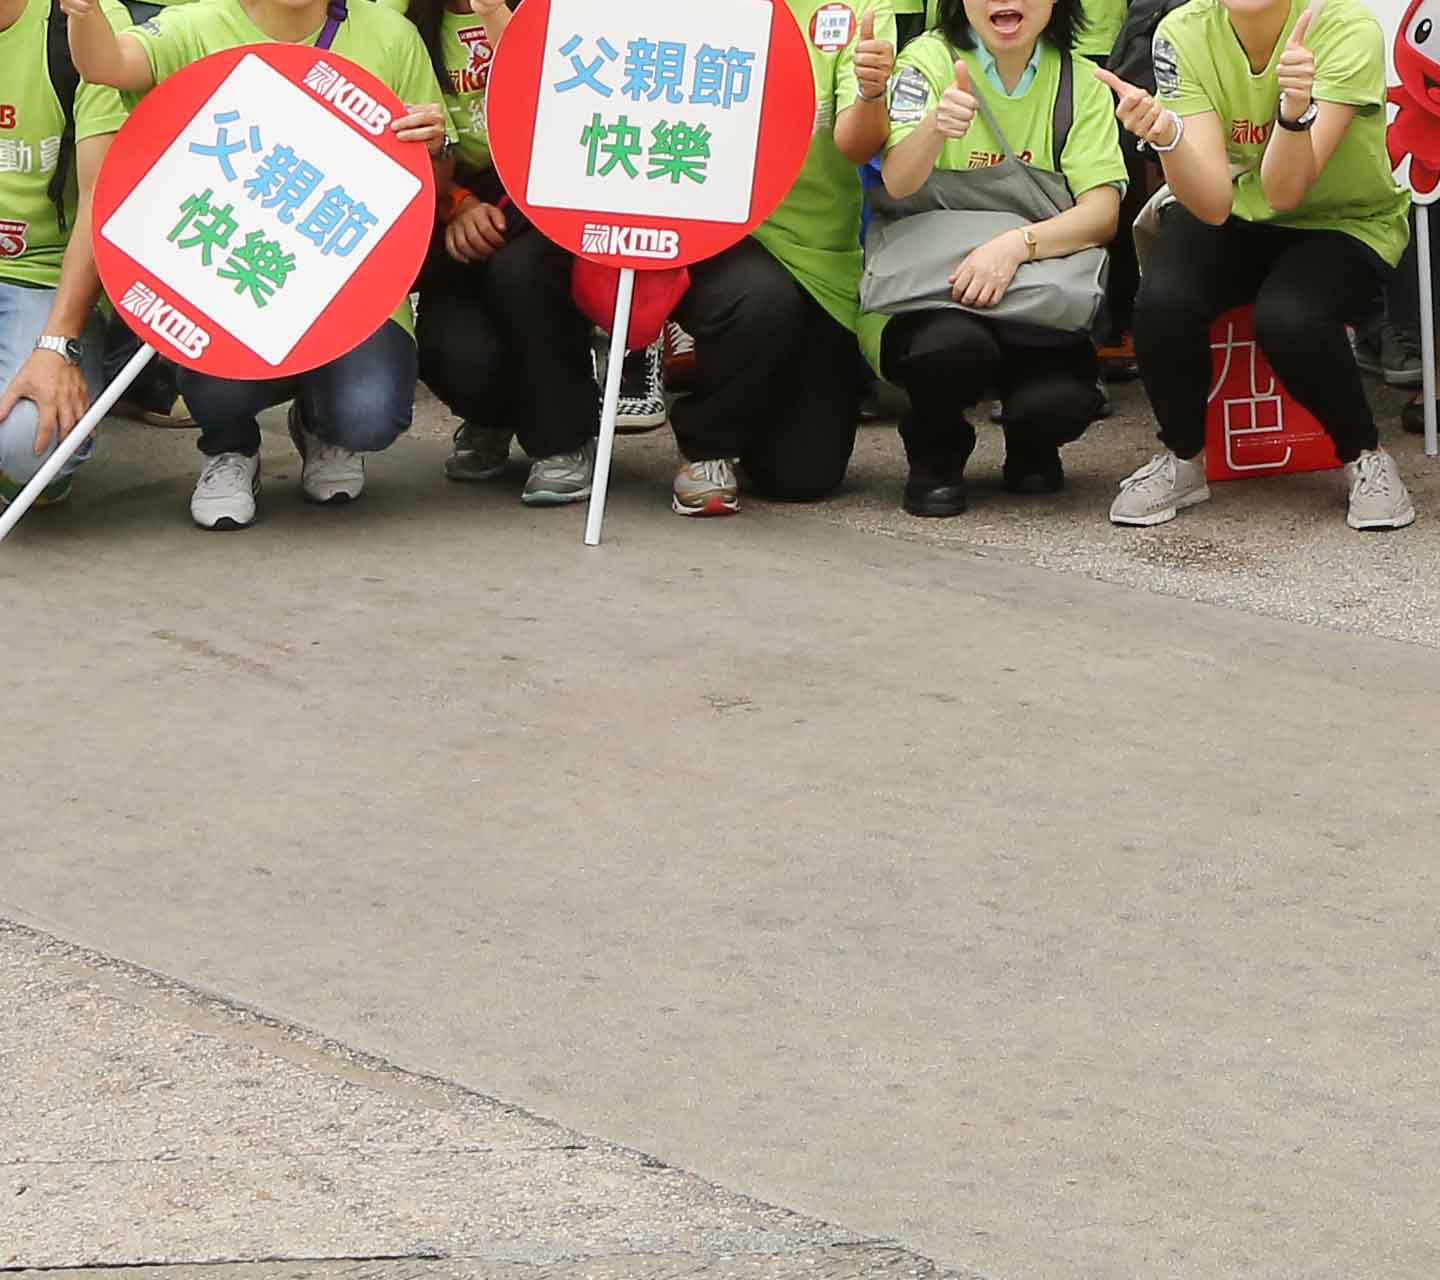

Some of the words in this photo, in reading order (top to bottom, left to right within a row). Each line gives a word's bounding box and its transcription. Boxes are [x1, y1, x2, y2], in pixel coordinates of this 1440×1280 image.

[325, 72, 394, 136] KMB
[553, 33, 757, 110] 父親節
[187, 109, 380, 258] 父親節
[580, 112, 713, 185] 快樂
[165, 187, 298, 309] 快樂
[608, 227, 680, 260] KMB
[144, 300, 213, 361] KMB
[1208, 328, 1292, 472] 九巴
